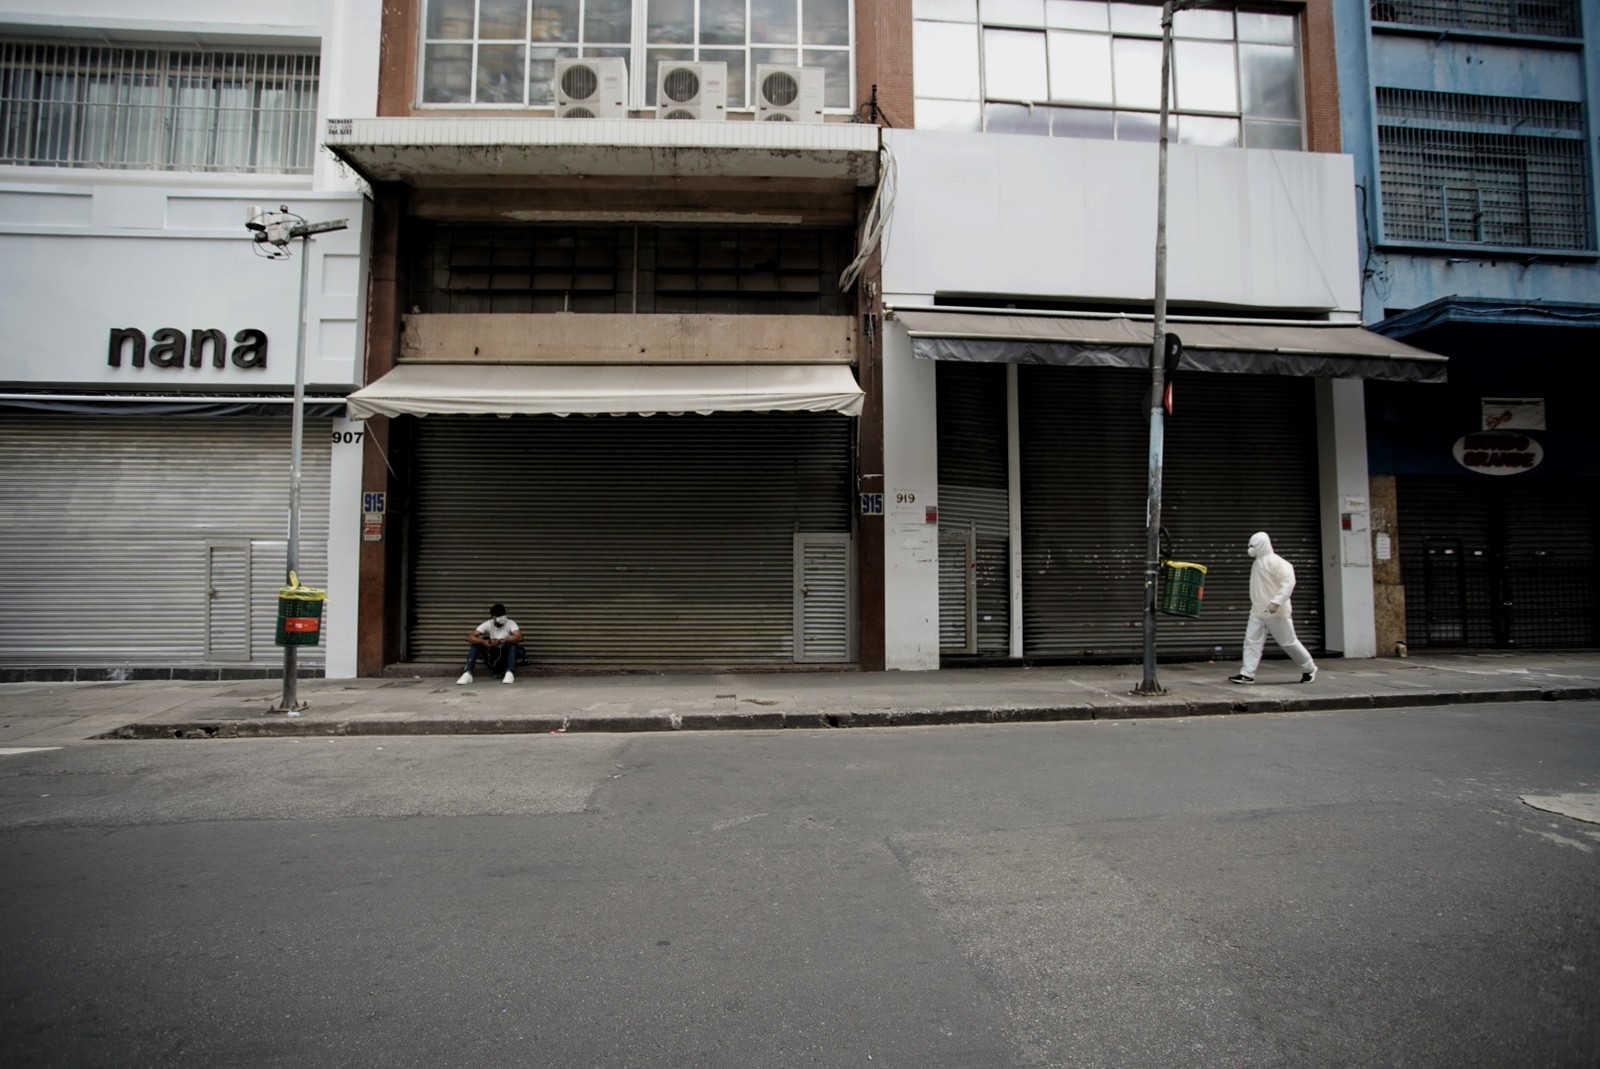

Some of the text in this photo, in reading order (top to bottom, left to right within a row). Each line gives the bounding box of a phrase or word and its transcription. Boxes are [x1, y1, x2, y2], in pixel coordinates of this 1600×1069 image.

[107, 327, 268, 369] nana
[332, 431, 364, 444] 907
[364, 492, 385, 512] 915
[862, 493, 882, 513] 915
[896, 493, 916, 504] 919
